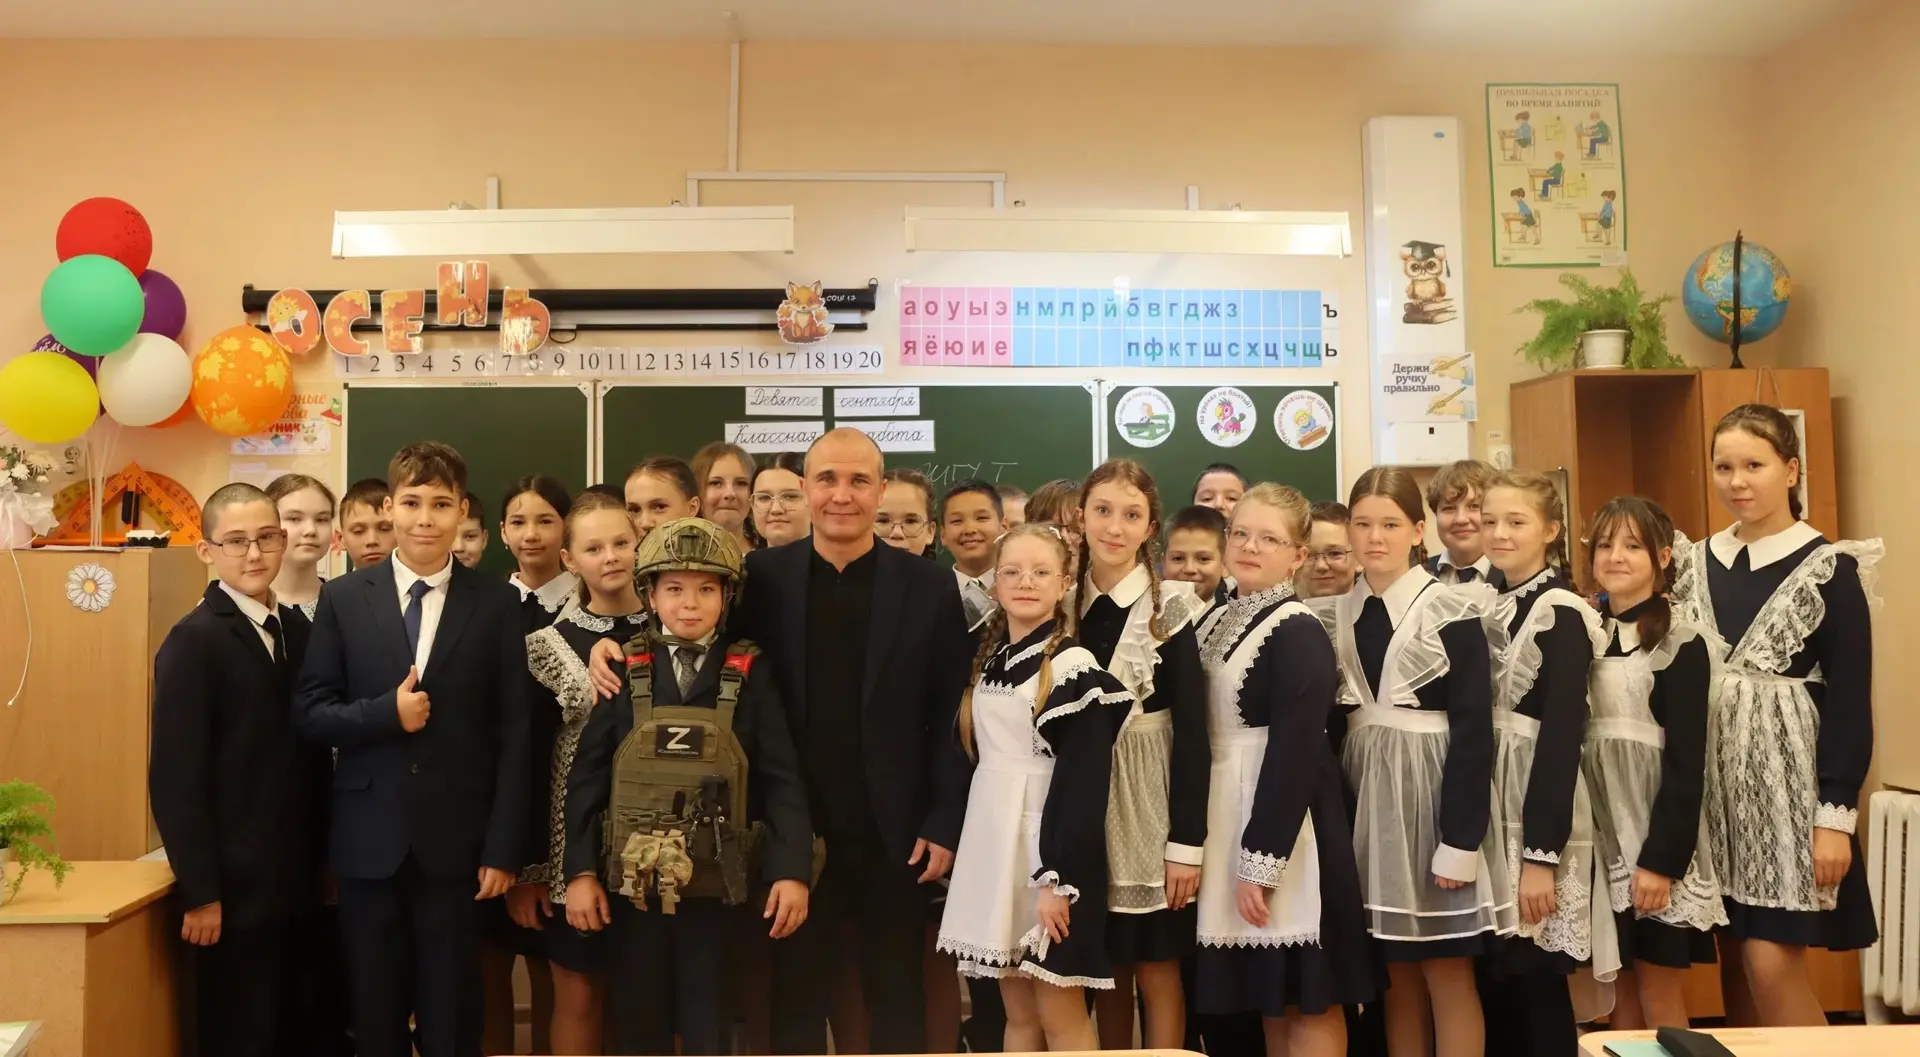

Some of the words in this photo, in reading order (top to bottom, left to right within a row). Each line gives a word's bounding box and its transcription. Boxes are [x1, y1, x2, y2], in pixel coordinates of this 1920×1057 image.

[267, 260, 550, 357] ОСЕНЬ
[904, 300, 917, 316] а
[924, 300, 939, 316] о
[947, 300, 961, 321] у
[969, 300, 988, 316] ы
[995, 300, 1008, 316] э
[1016, 300, 1030, 316] н
[1038, 301, 1054, 317] м
[1060, 301, 1074, 317] л
[1081, 301, 1096, 322] р
[1104, 298, 1117, 318] й
[1126, 296, 1140, 318] б
[1147, 302, 1161, 318] в
[1168, 302, 1179, 318] г
[1183, 302, 1200, 321] д
[1203, 302, 1221, 318] ж
[1227, 302, 1238, 318] з
[1322, 303, 1338, 318] ъ
[903, 340, 917, 355] я
[925, 334, 938, 356] ё
[944, 340, 964, 356] ю
[971, 340, 985, 356] и
[994, 340, 1008, 356] е
[1127, 341, 1140, 357] п
[1143, 336, 1164, 362] ф
[1169, 342, 1180, 357] к
[1185, 342, 1198, 357] т
[1204, 342, 1222, 357] ш
[1227, 342, 1240, 358] с
[1247, 342, 1259, 357] х
[1264, 342, 1279, 361] ц
[1284, 342, 1297, 357] ч
[1302, 342, 1321, 361] щ
[1325, 343, 1338, 357] ь
[343, 355, 353, 373] 1
[369, 355, 380, 373] 2
[395, 354, 405, 372] 3
[421, 355, 434, 372] 4
[451, 355, 461, 372] 5
[474, 354, 486, 371] 6
[502, 354, 513, 372] 7
[526, 351, 539, 371] 8
[553, 352, 565, 370] 9
[580, 352, 600, 370] 10
[608, 353, 625, 370] 11
[636, 352, 656, 371] 12
[664, 353, 684, 371] 13
[692, 352, 712, 370] 14
[720, 351, 740, 369] 15
[749, 351, 769, 369] 16
[776, 351, 797, 369] 17
[805, 352, 825, 369] 18
[833, 352, 853, 369] 19
[859, 351, 882, 368] 20
[1392, 363, 1430, 375] Держи
[1383, 384, 1441, 394] правильно
[1395, 375, 1427, 384] ручку
[750, 387, 819, 406] Девятое
[840, 388, 916, 414] сентября
[734, 424, 818, 444] Классная
[866, 422, 928, 442] абота.
[666, 726, 692, 750] Z
